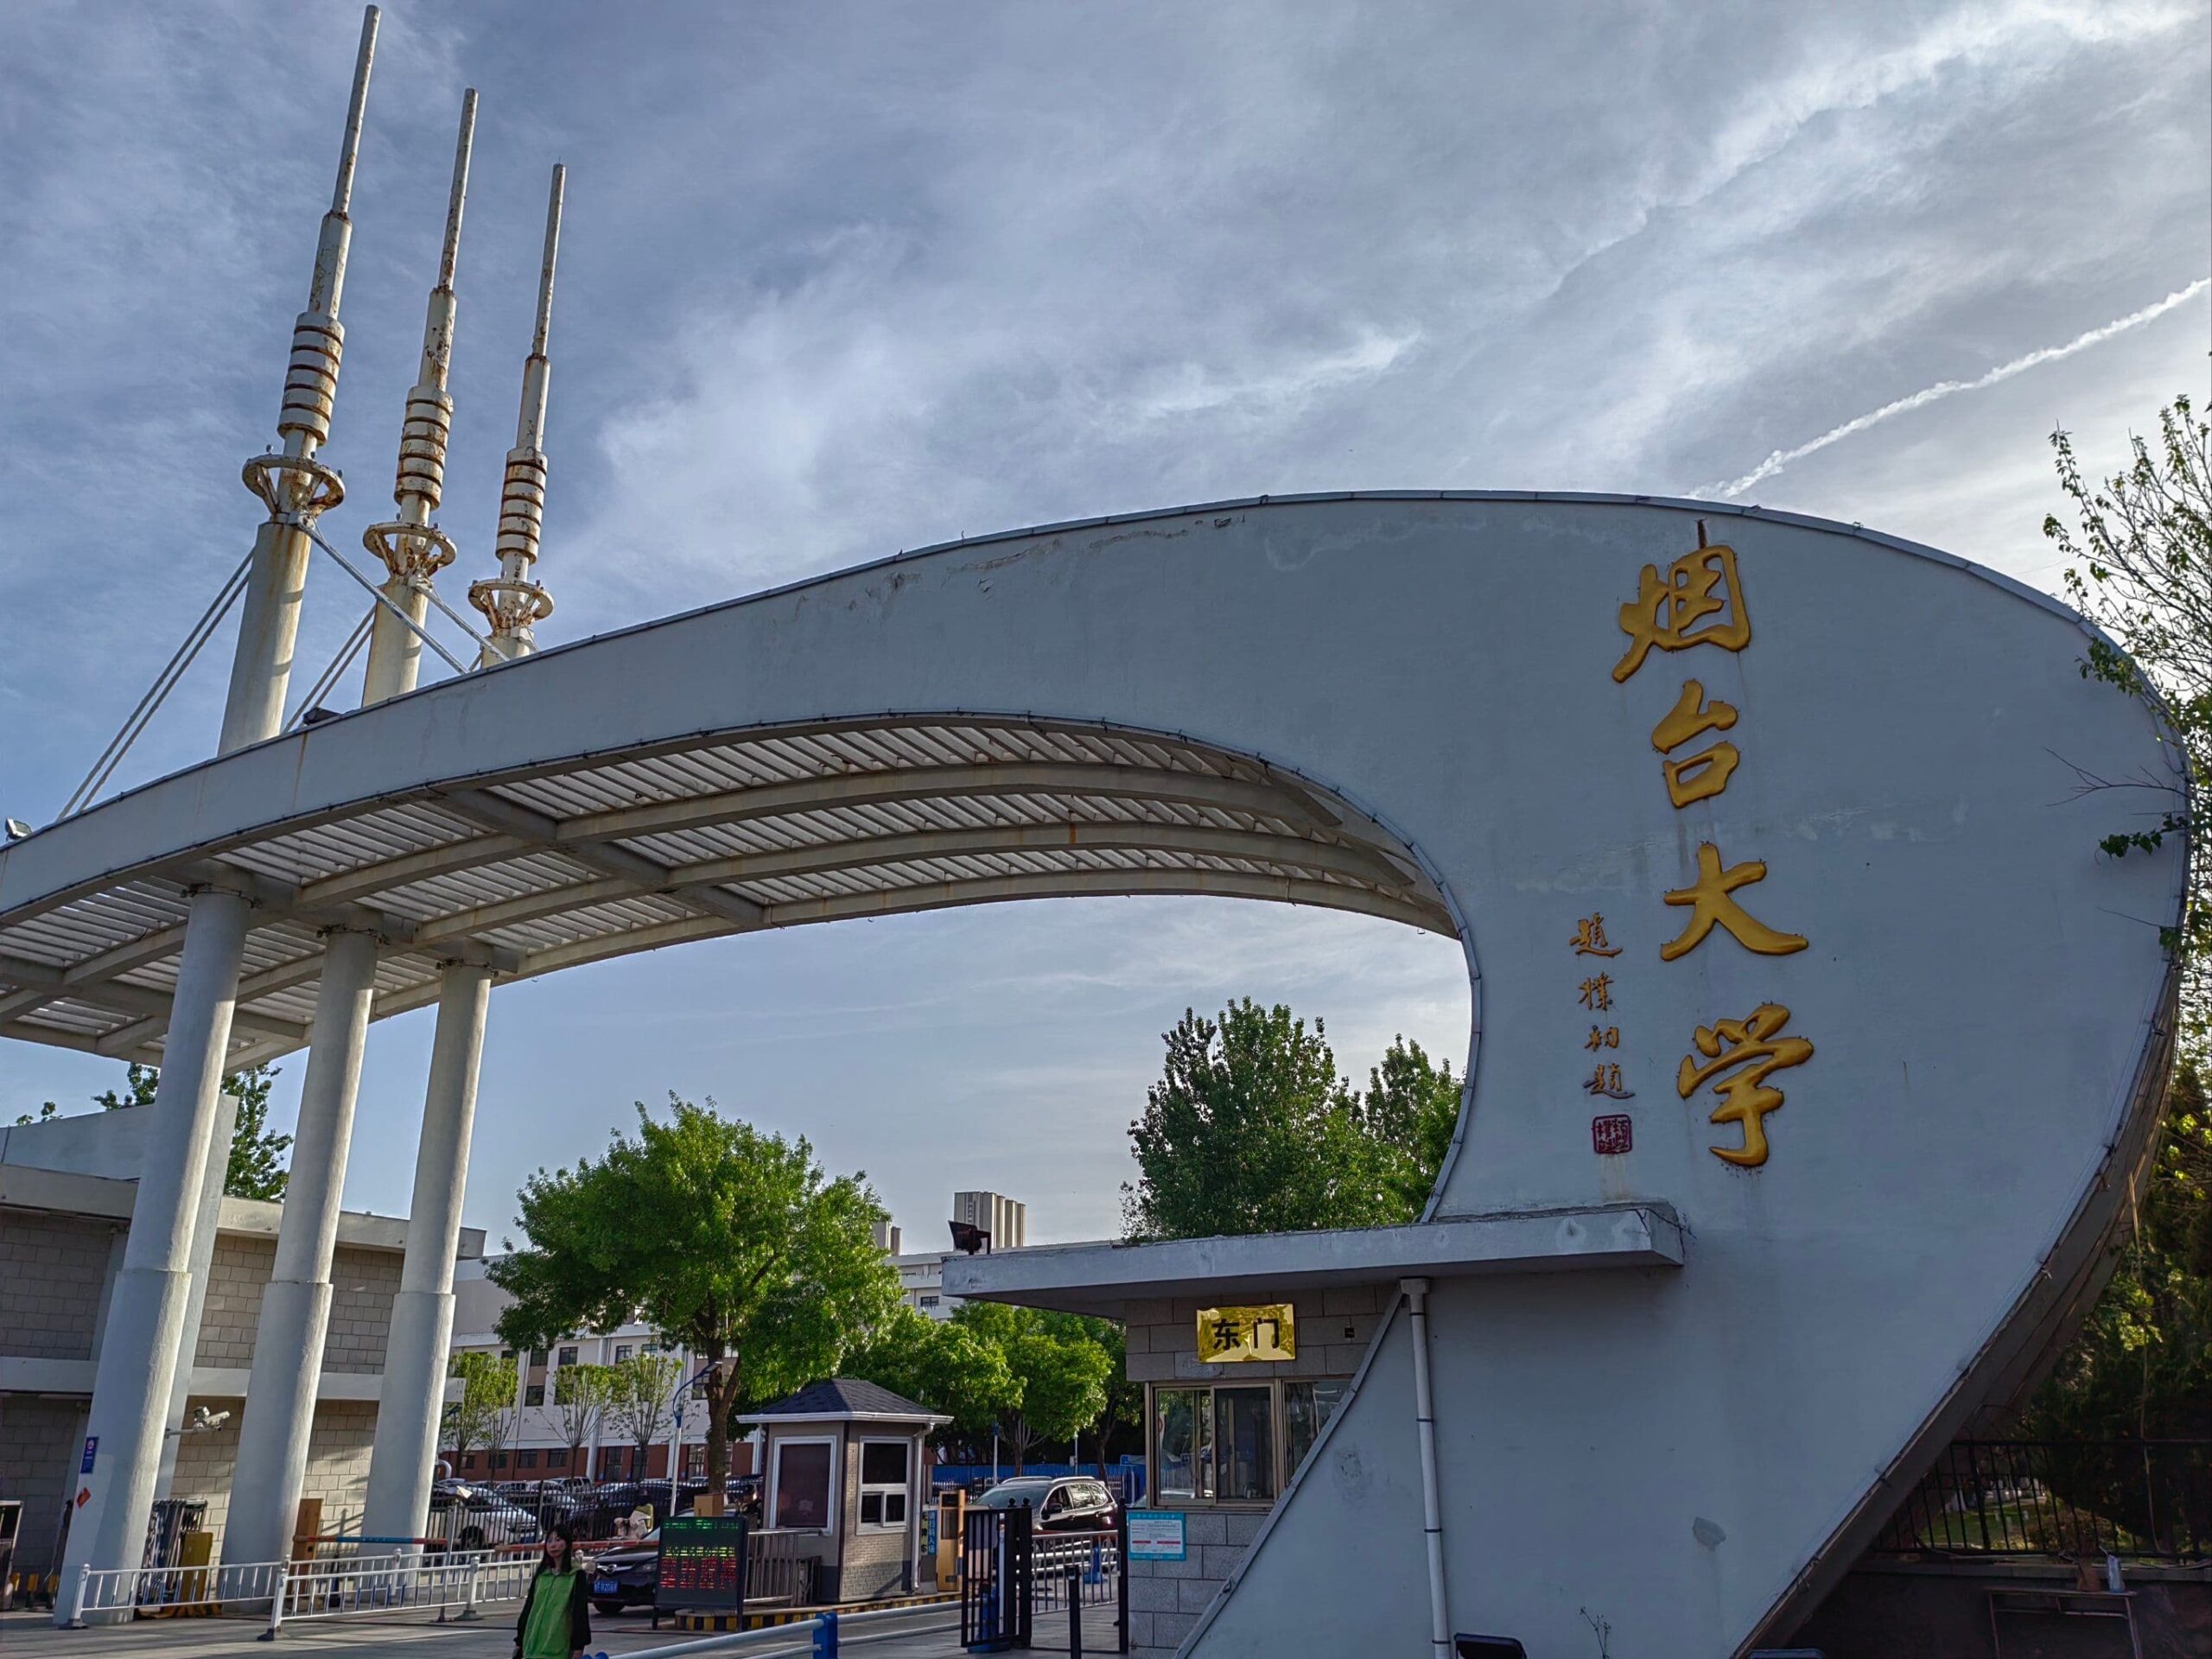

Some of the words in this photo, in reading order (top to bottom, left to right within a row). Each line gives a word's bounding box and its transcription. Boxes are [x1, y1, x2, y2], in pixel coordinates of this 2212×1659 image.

[1612, 544, 1814, 1167] 烟台大学
[1211, 1317, 1280, 1351] 东门
